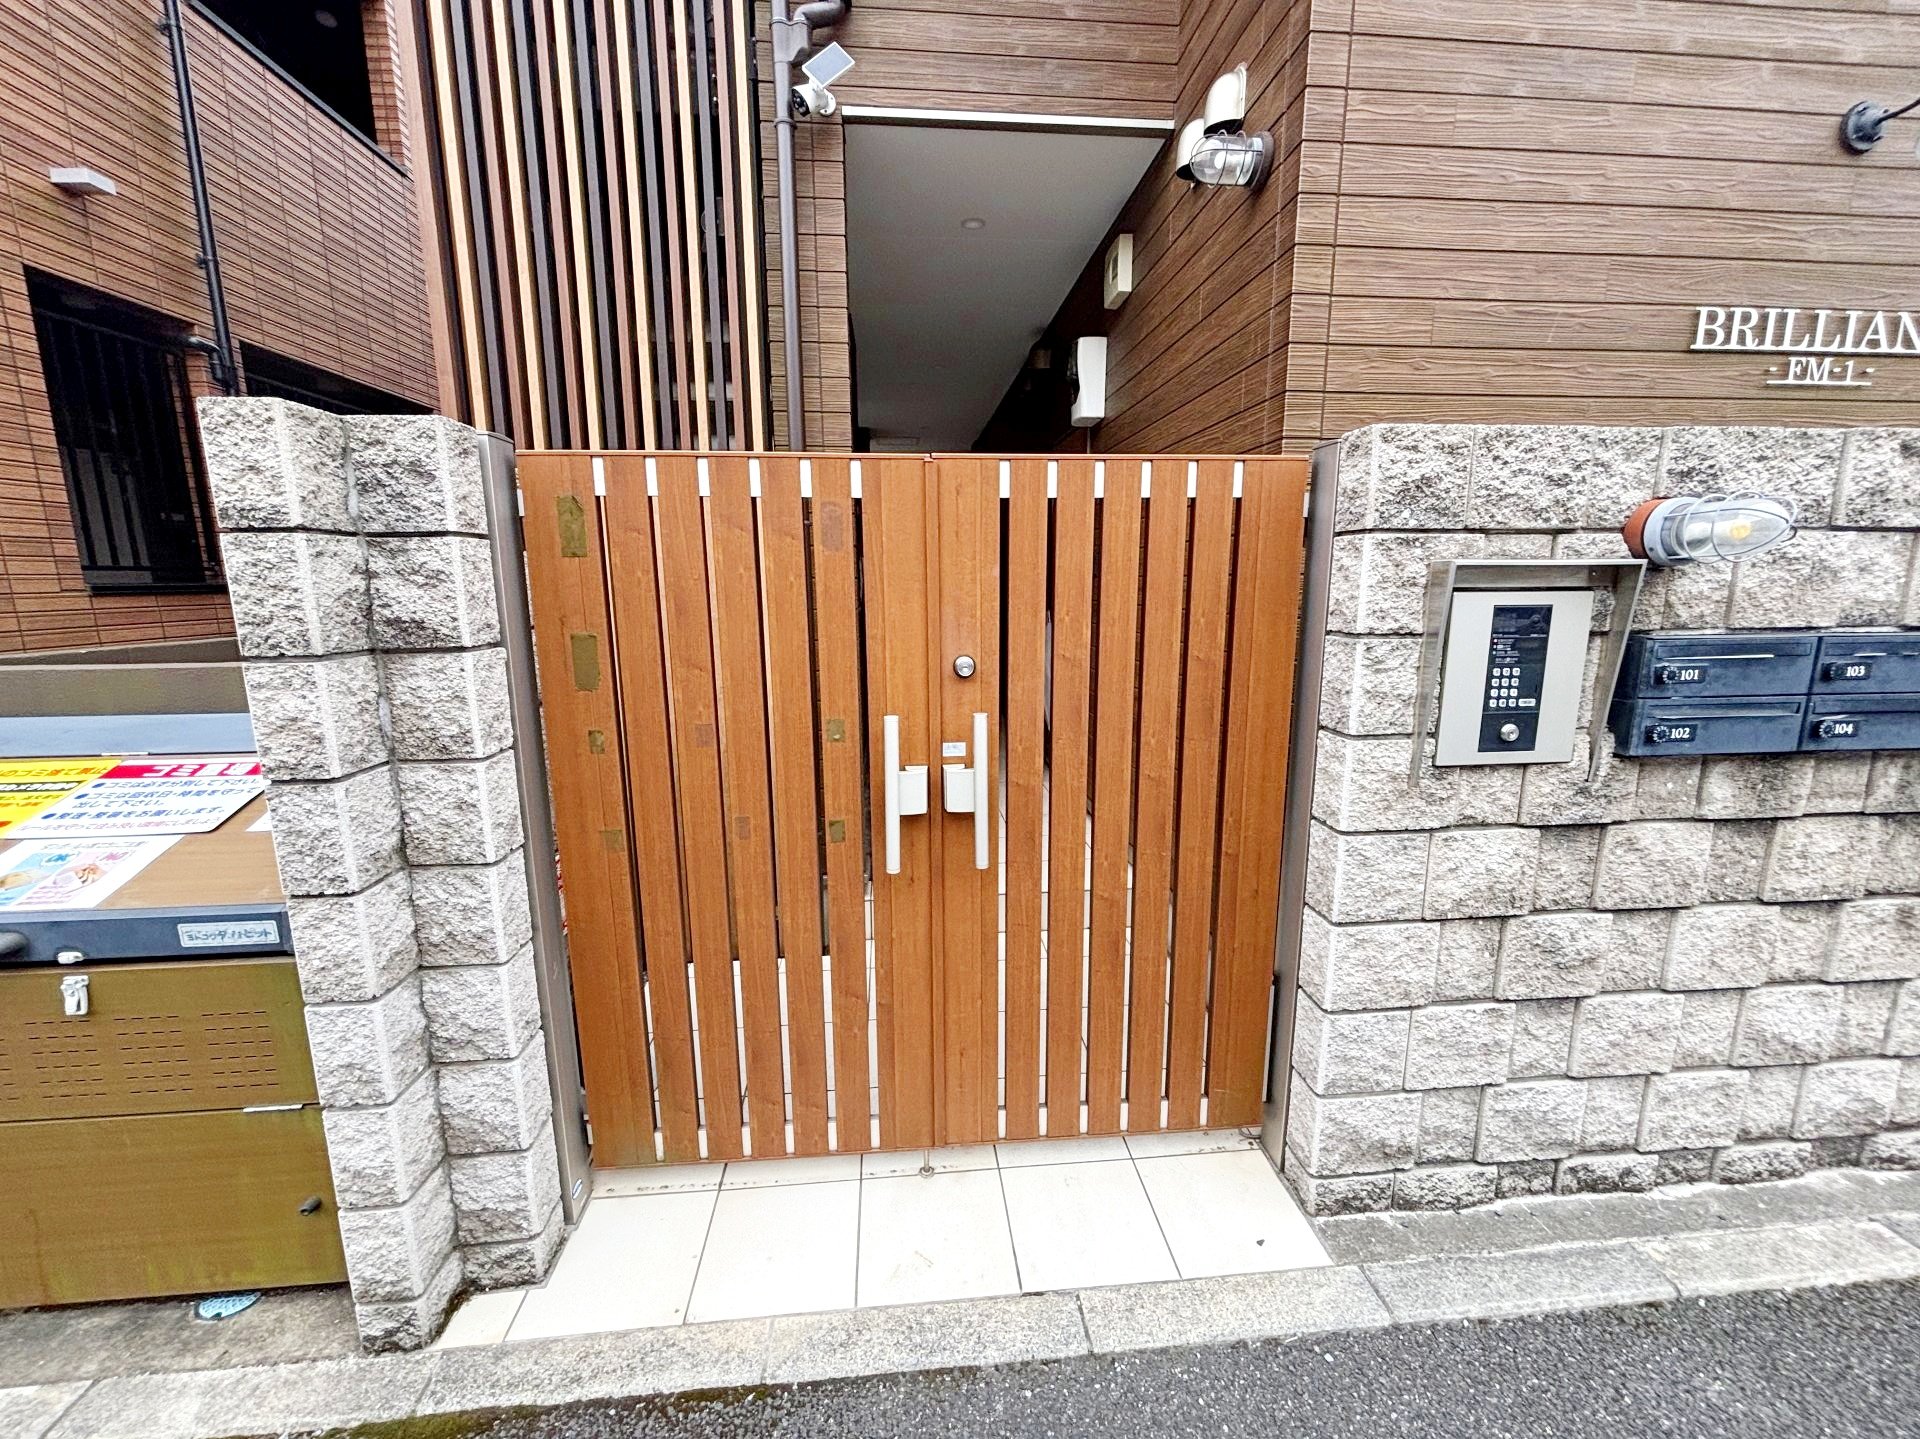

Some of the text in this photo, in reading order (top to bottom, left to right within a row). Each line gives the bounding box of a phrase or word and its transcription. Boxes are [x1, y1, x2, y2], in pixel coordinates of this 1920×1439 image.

[1690, 306, 1920, 351] BRILLIAN
[1680, 669, 1699, 681] 101
[1846, 665, 1866, 677] 103
[1670, 727, 1690, 739] 102
[1834, 723, 1854, 734] 104
